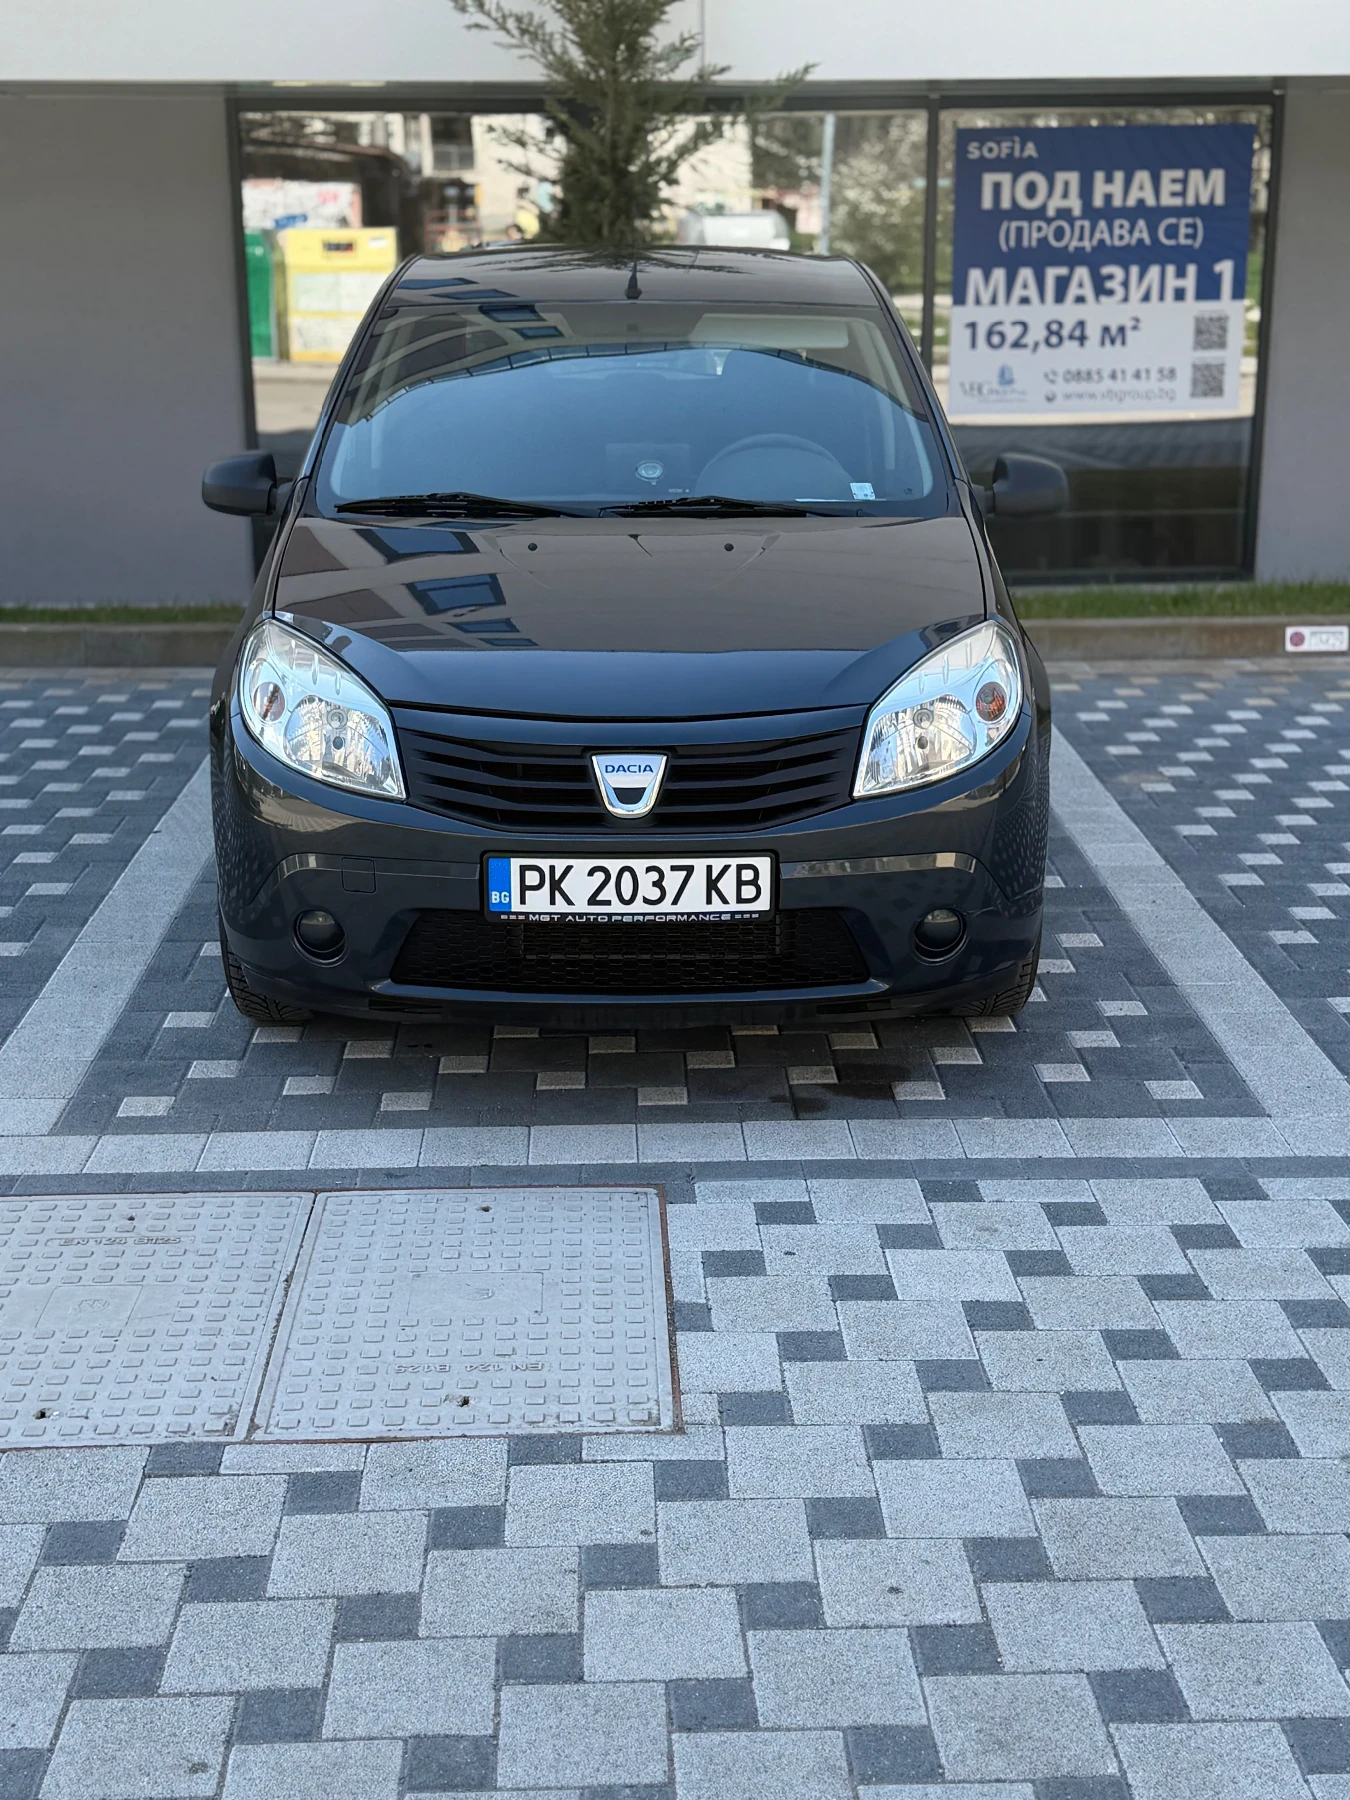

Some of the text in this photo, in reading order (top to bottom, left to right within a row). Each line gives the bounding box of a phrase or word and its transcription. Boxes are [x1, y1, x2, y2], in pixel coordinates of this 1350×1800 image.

[980, 168, 1226, 217] ПОД НАЕМ
[999, 217, 1204, 253] (ПРОДАВА СЕ)
[966, 259, 1236, 306] МАГАЗИН 1
[963, 320, 1089, 353] 162,84
[1108, 367, 1127, 382] 41
[1131, 367, 1152, 382] 41
[605, 764, 654, 774] DACIA
[518, 863, 763, 907] PK 2037 KB
[491, 891, 510, 905] BG
[528, 913, 732, 923] MGT AUTO PERFORMANCE
[394, 1361, 545, 1374] EN 124 B125
